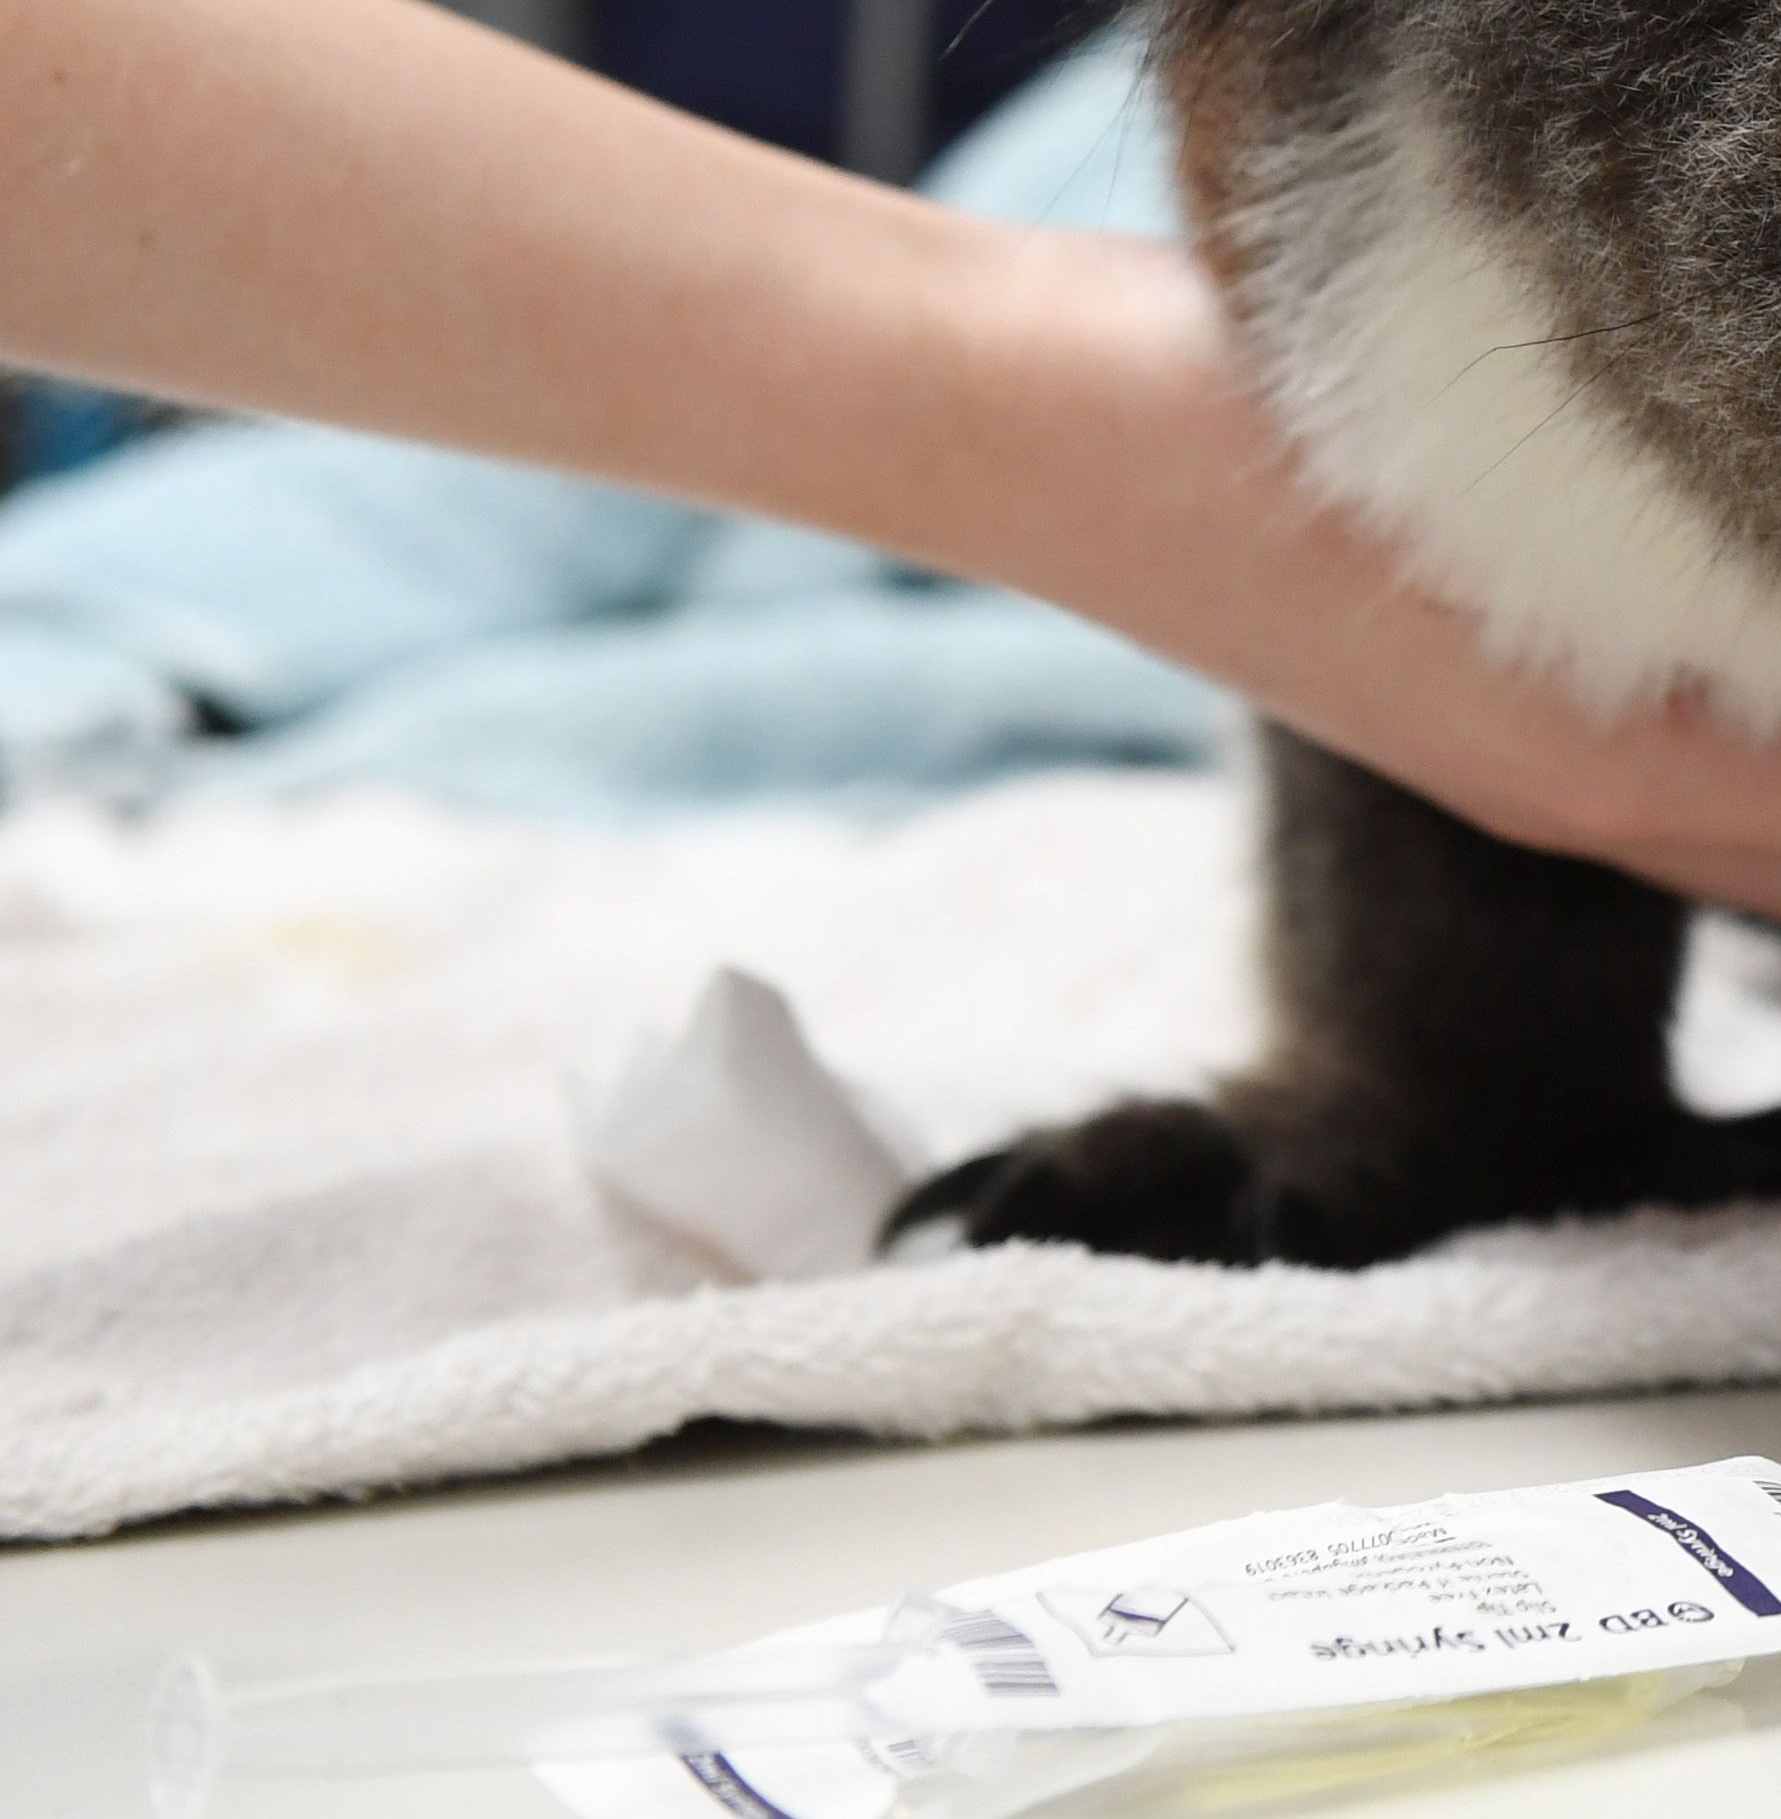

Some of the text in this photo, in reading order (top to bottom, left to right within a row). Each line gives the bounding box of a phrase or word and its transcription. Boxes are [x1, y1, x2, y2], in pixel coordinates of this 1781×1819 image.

[1476, 1600, 1557, 1617] Slip Tip
[1310, 1609, 1665, 1661] BD 2ml Syringe
